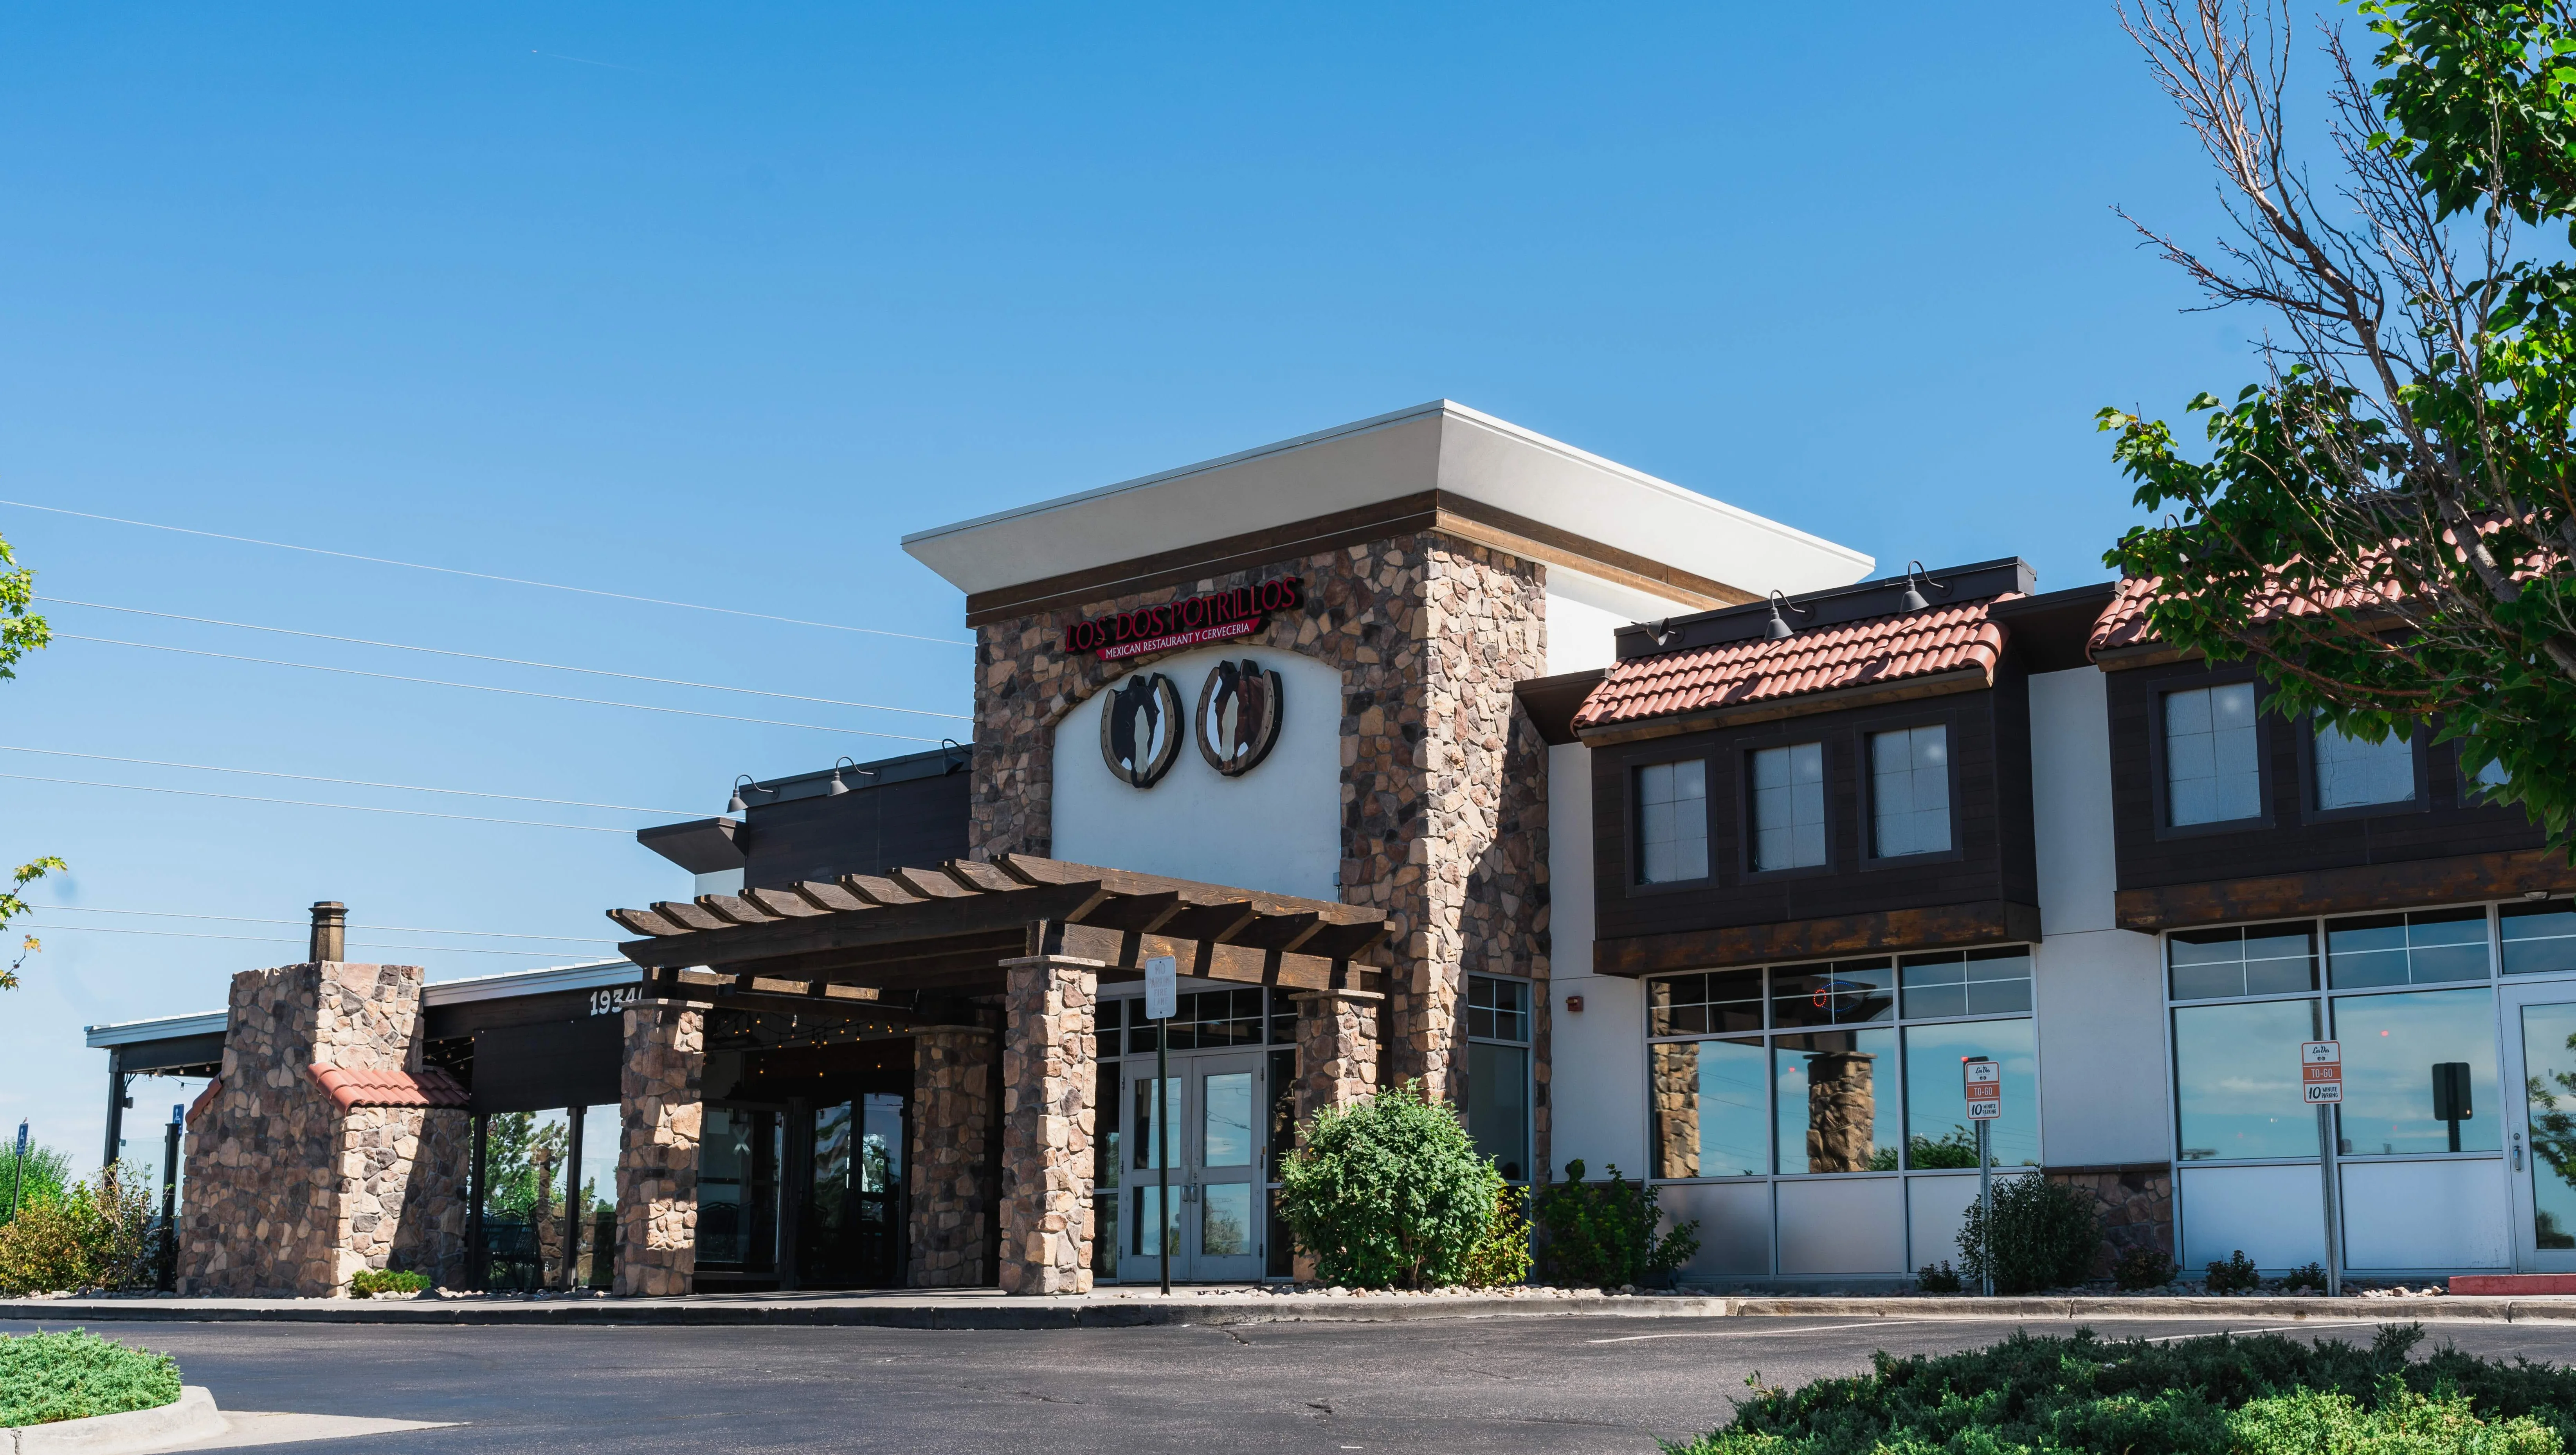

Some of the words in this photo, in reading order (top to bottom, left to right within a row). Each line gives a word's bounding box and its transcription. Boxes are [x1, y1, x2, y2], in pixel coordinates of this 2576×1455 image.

[1065, 617, 1106, 652] LOS
[1116, 606, 1164, 640] DOS
[1171, 577, 1297, 630] POTRILLOS
[1106, 643, 1141, 659] MEXICAN
[1143, 632, 1193, 651] RESTAURANT
[1194, 632, 1201, 640] Y
[1202, 623, 1250, 640] CERVECERIA
[1155, 963, 1166, 974] NO
[1154, 988, 1167, 996] FIRE
[590, 987, 643, 1016] 1934
[2311, 1068, 2333, 1078] TO-GO
[1974, 1087, 1992, 1096] TO-GO
[2309, 1087, 2321, 1099] 10
[1971, 1104, 1982, 1115] 10
